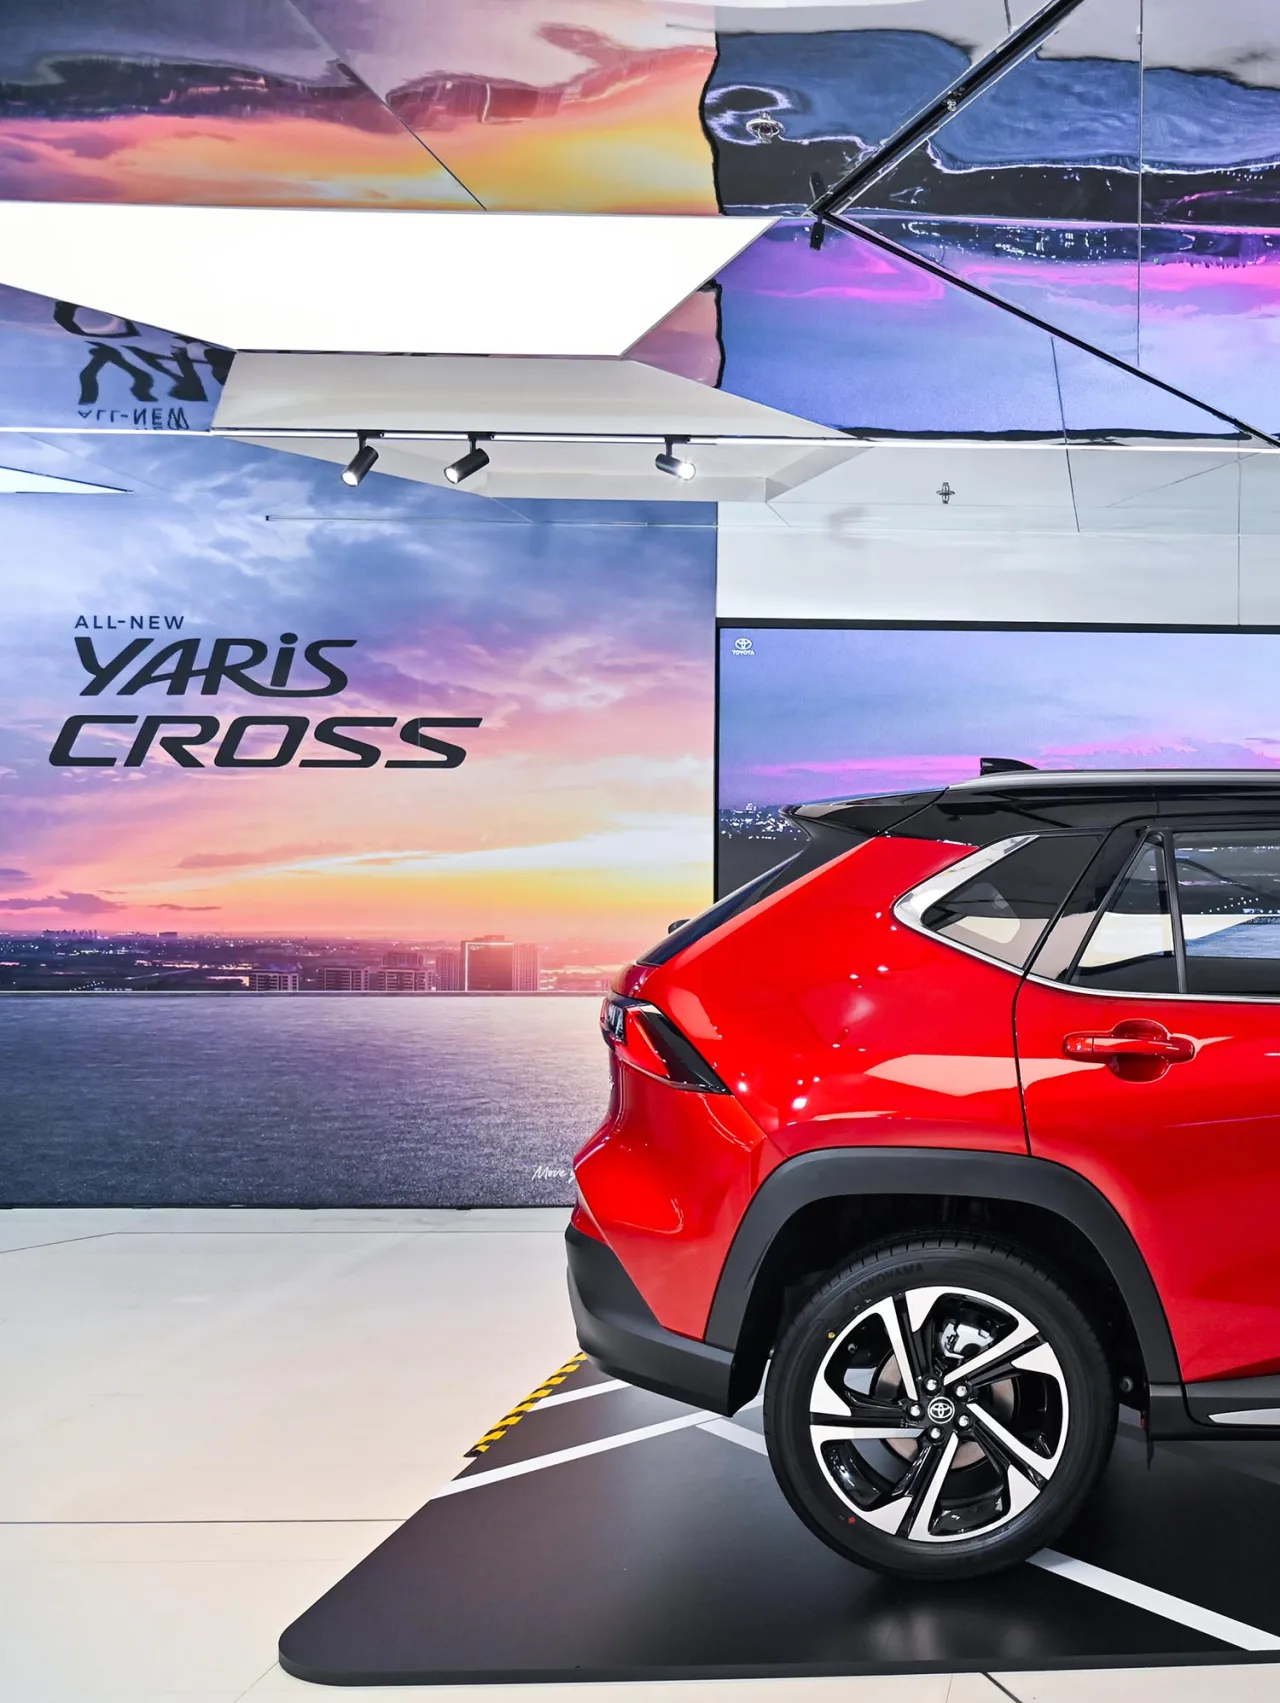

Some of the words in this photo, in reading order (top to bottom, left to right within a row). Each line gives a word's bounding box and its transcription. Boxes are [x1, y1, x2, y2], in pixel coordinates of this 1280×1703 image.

[73, 615, 185, 630] ALL-NEW
[48, 714, 484, 769] CROSS
[531, 1165, 567, 1181] Move
[852, 1263, 924, 1293] YOKOHAMA
